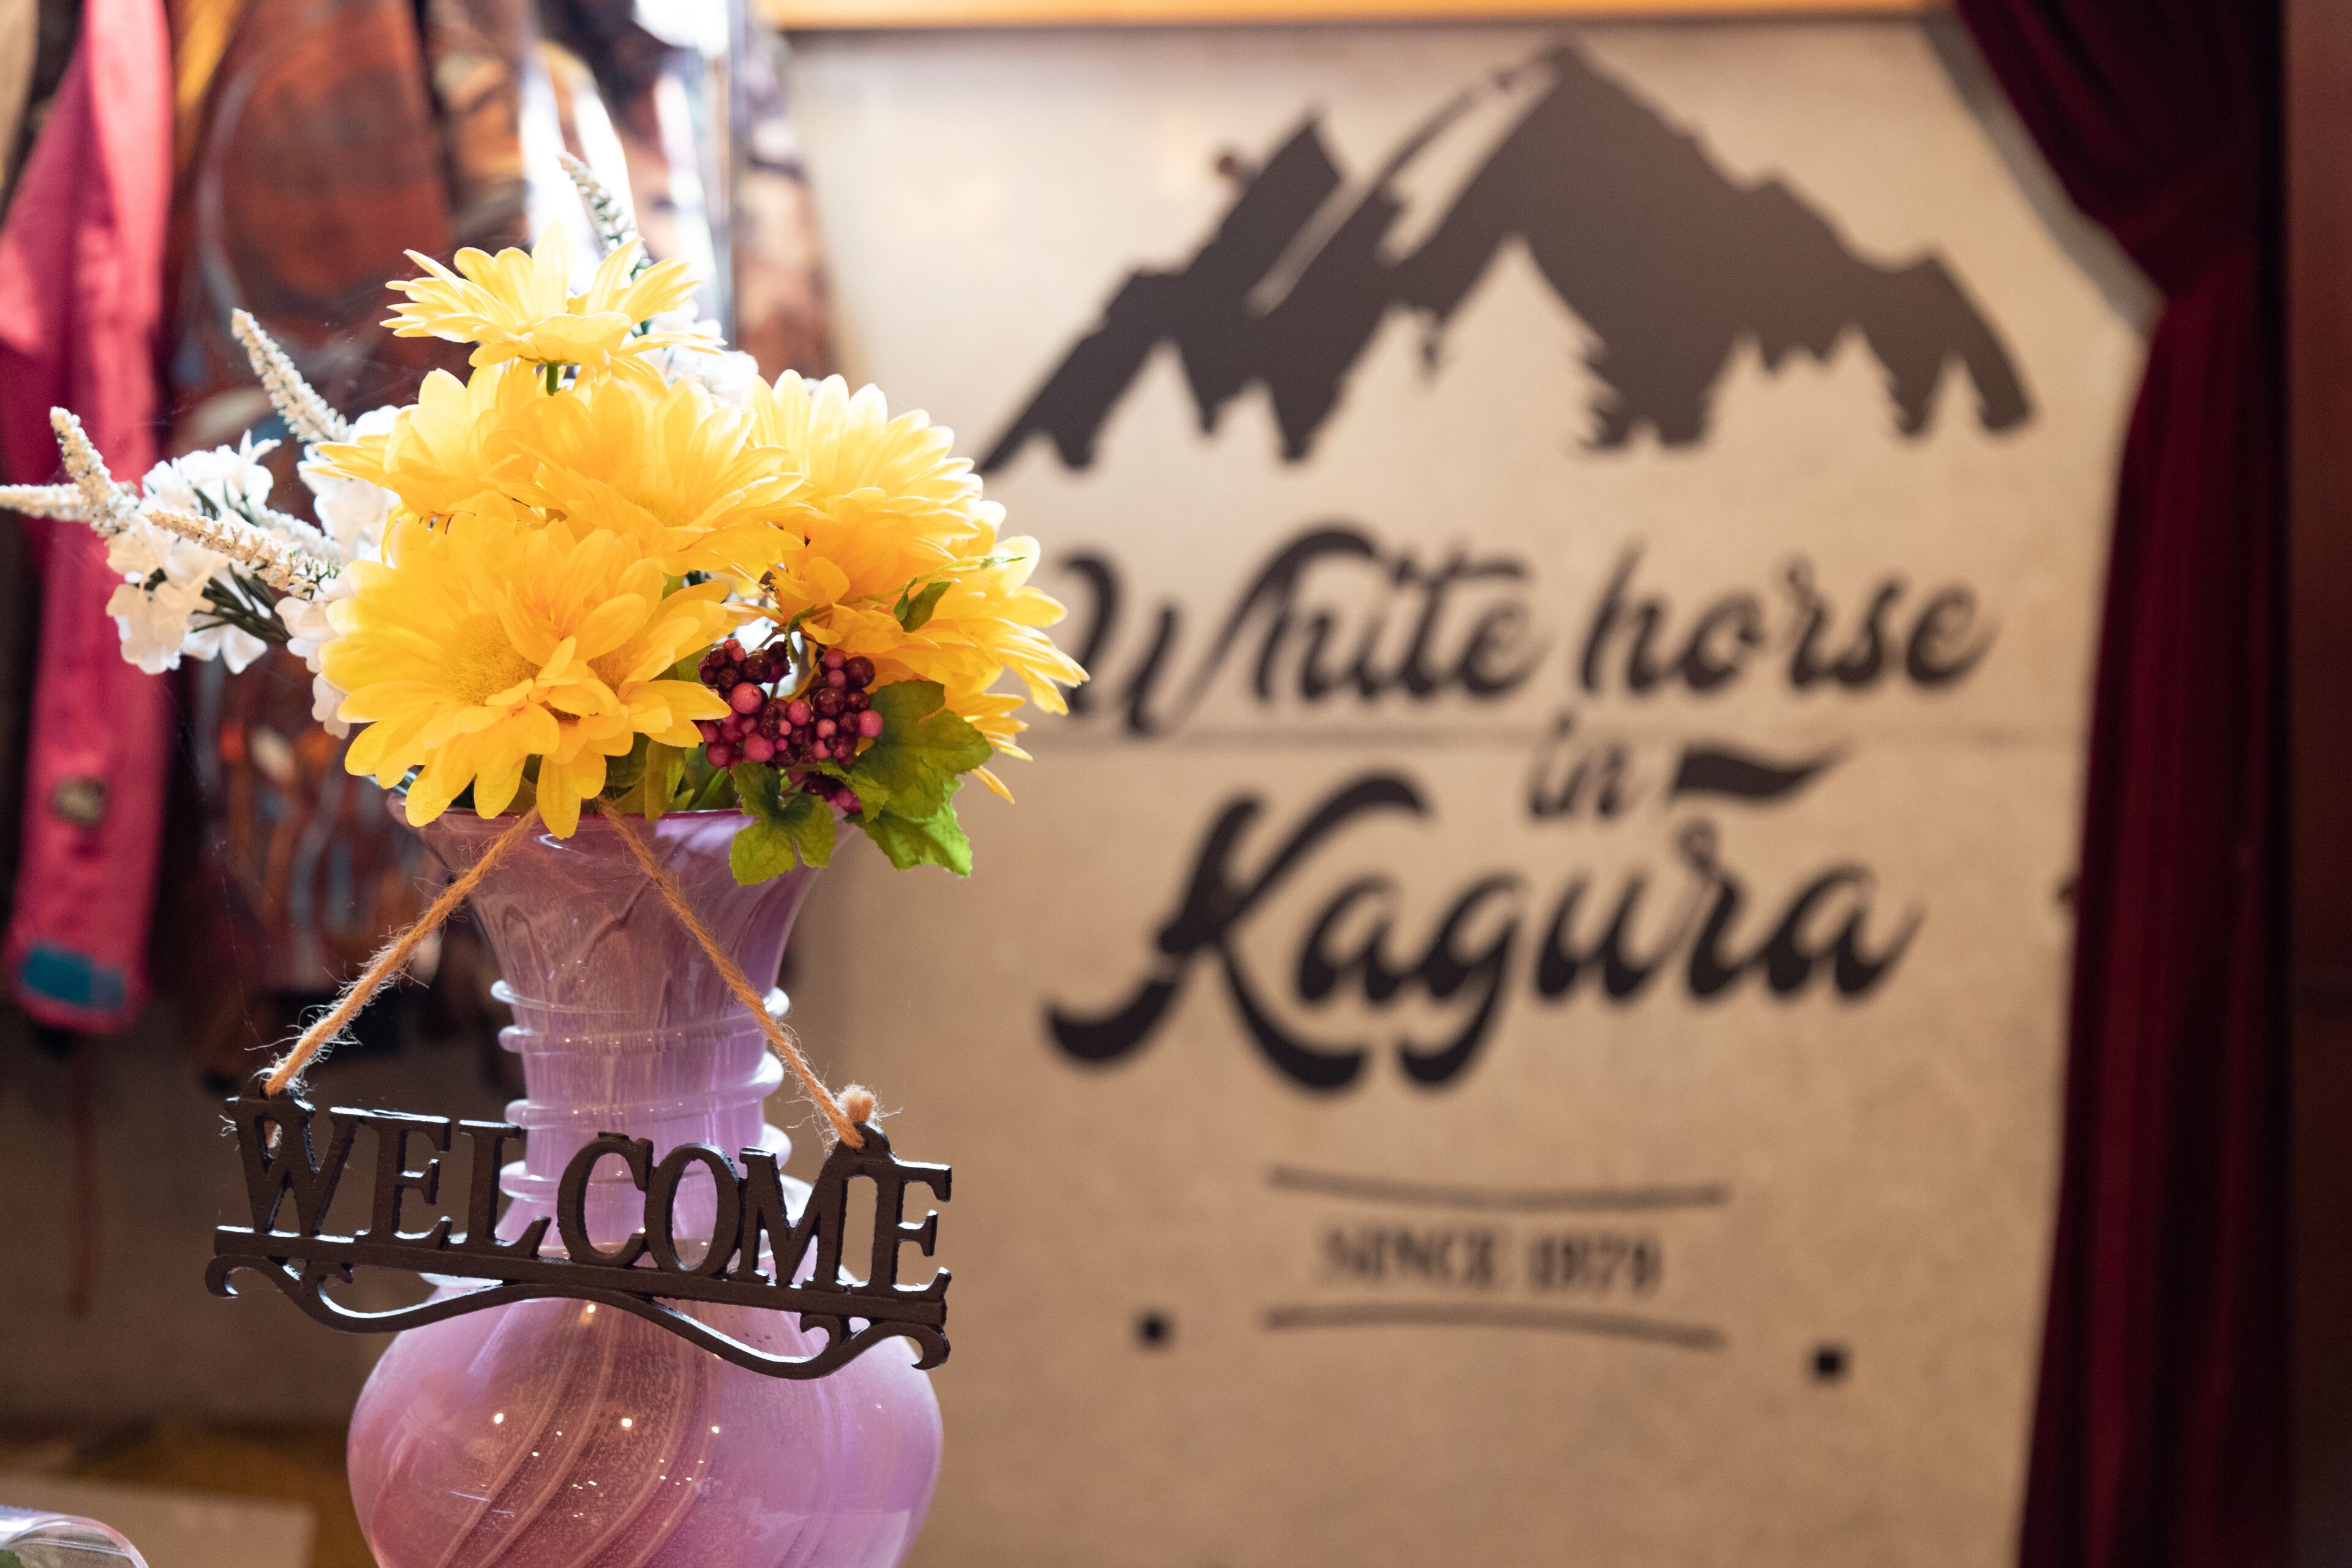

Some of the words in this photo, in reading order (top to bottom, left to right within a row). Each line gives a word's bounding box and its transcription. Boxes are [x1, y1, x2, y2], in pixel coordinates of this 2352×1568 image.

[1055, 524, 1551, 738] White
[1579, 532, 2000, 699] horse
[1523, 710, 1648, 827] in
[1044, 769, 1923, 1093] Kagura
[227, 1096, 953, 1294] WELCOME
[1316, 1222, 1504, 1289] SINCE
